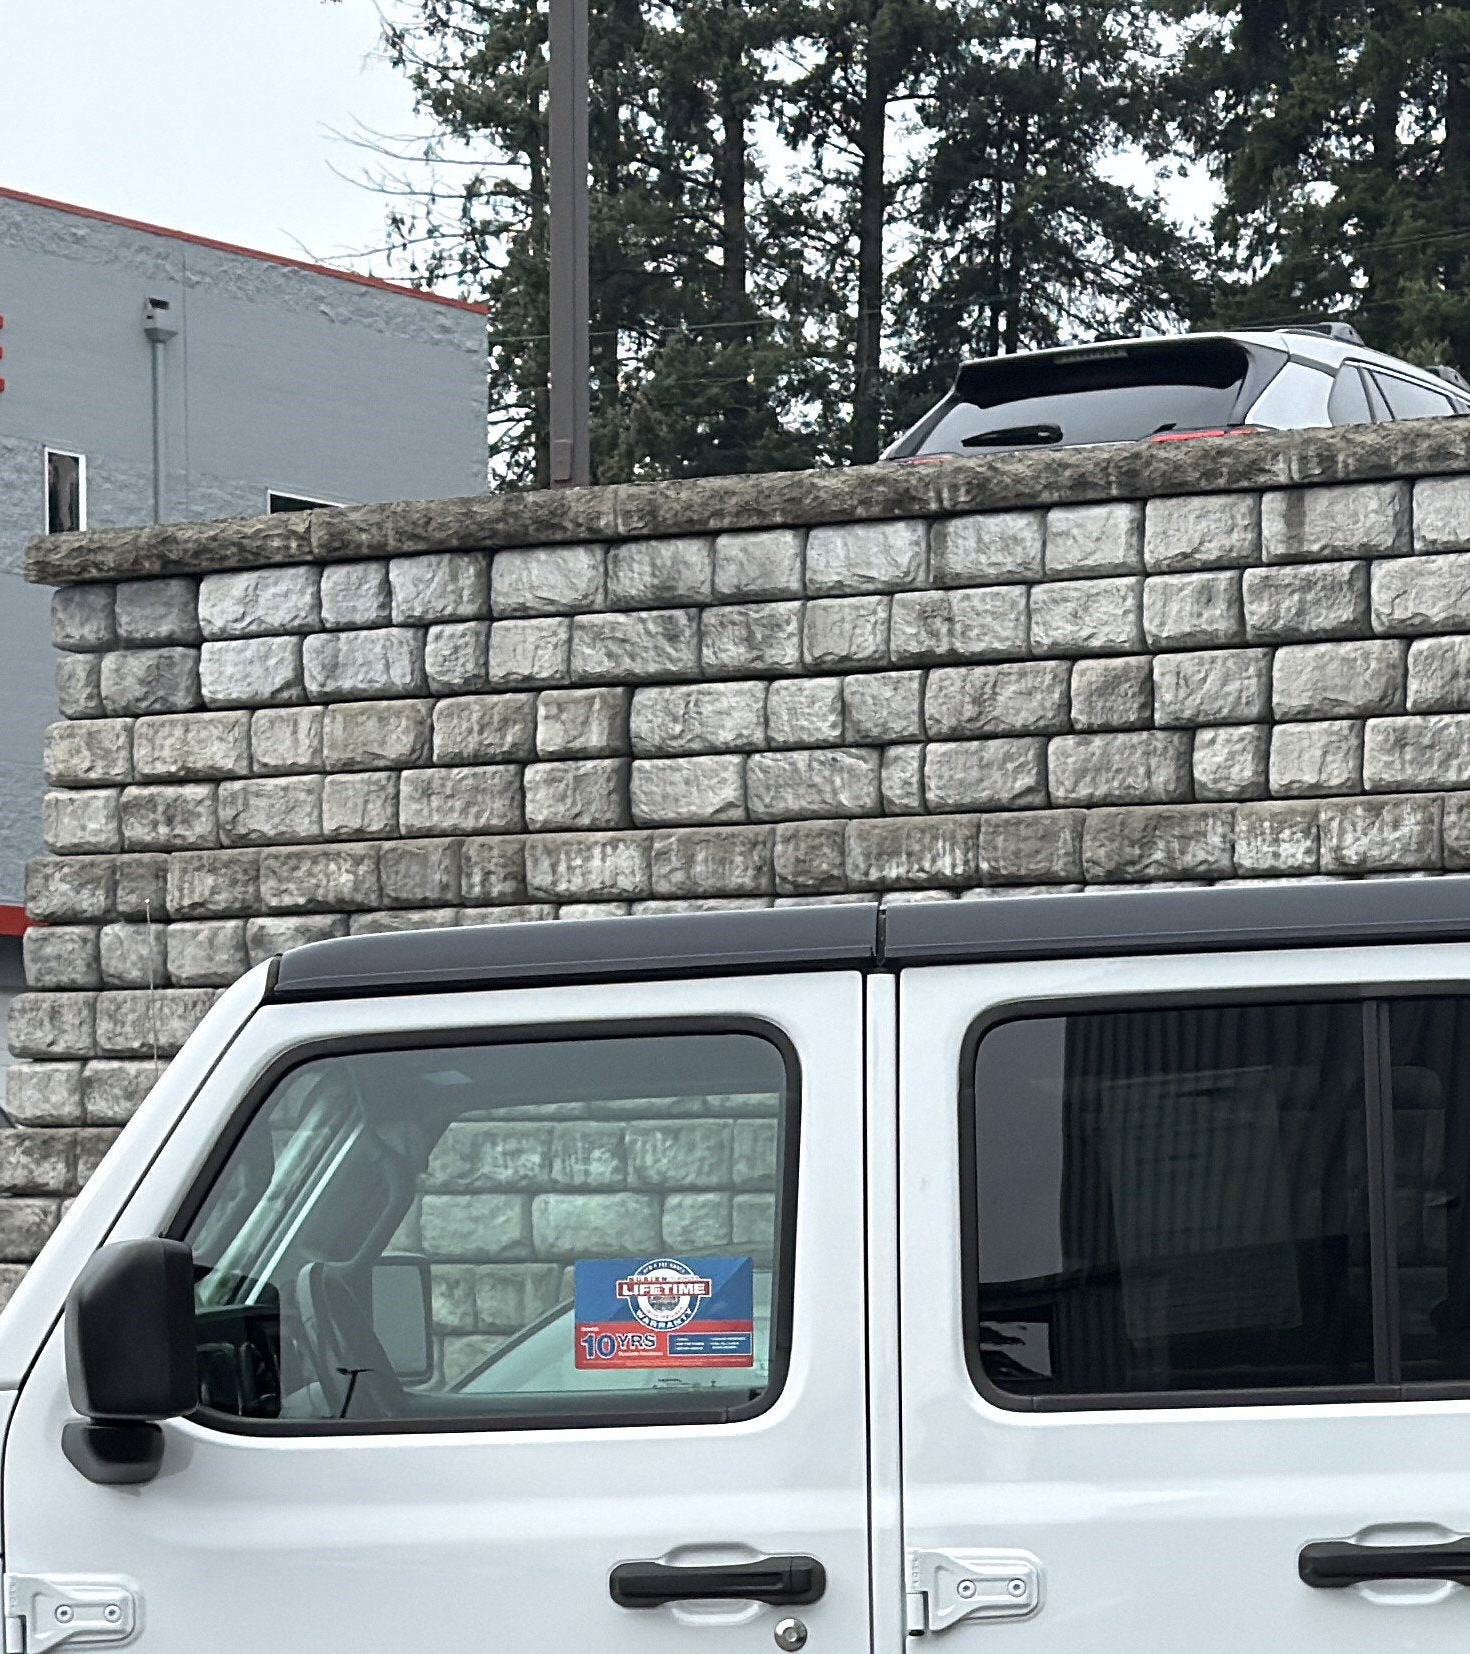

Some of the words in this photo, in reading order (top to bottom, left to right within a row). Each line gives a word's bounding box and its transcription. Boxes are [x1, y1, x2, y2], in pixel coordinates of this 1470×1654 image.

[622, 1283, 706, 1295] LIFETIME
[636, 1307, 692, 1329] WARRANTY
[581, 1333, 617, 1359] 10
[616, 1333, 657, 1349] YRS
